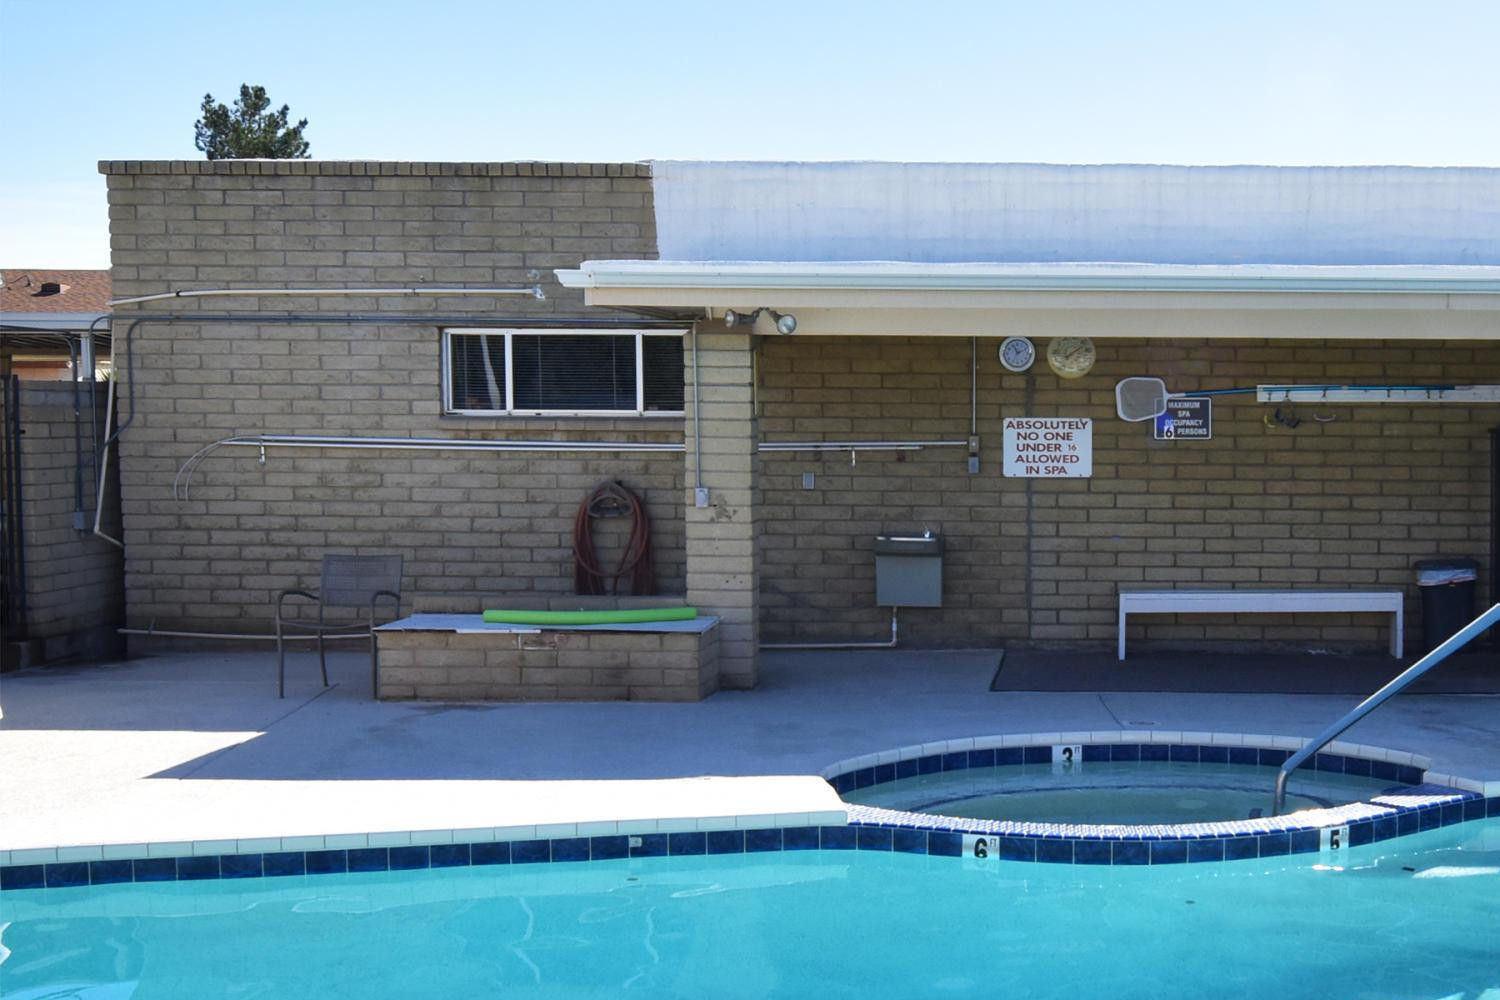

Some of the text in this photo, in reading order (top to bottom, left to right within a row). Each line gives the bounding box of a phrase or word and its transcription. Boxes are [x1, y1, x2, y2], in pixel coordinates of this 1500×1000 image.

[1006, 420, 1088, 430] ABSOLUTELY
[1017, 432, 1073, 441] NO ONE
[1016, 443, 1062, 452] UNDER
[1014, 454, 1080, 464] ALLOWED
[1025, 466, 1068, 475] IN SPA
[1330, 829, 1340, 850] 5
[974, 837, 988, 858] 6
